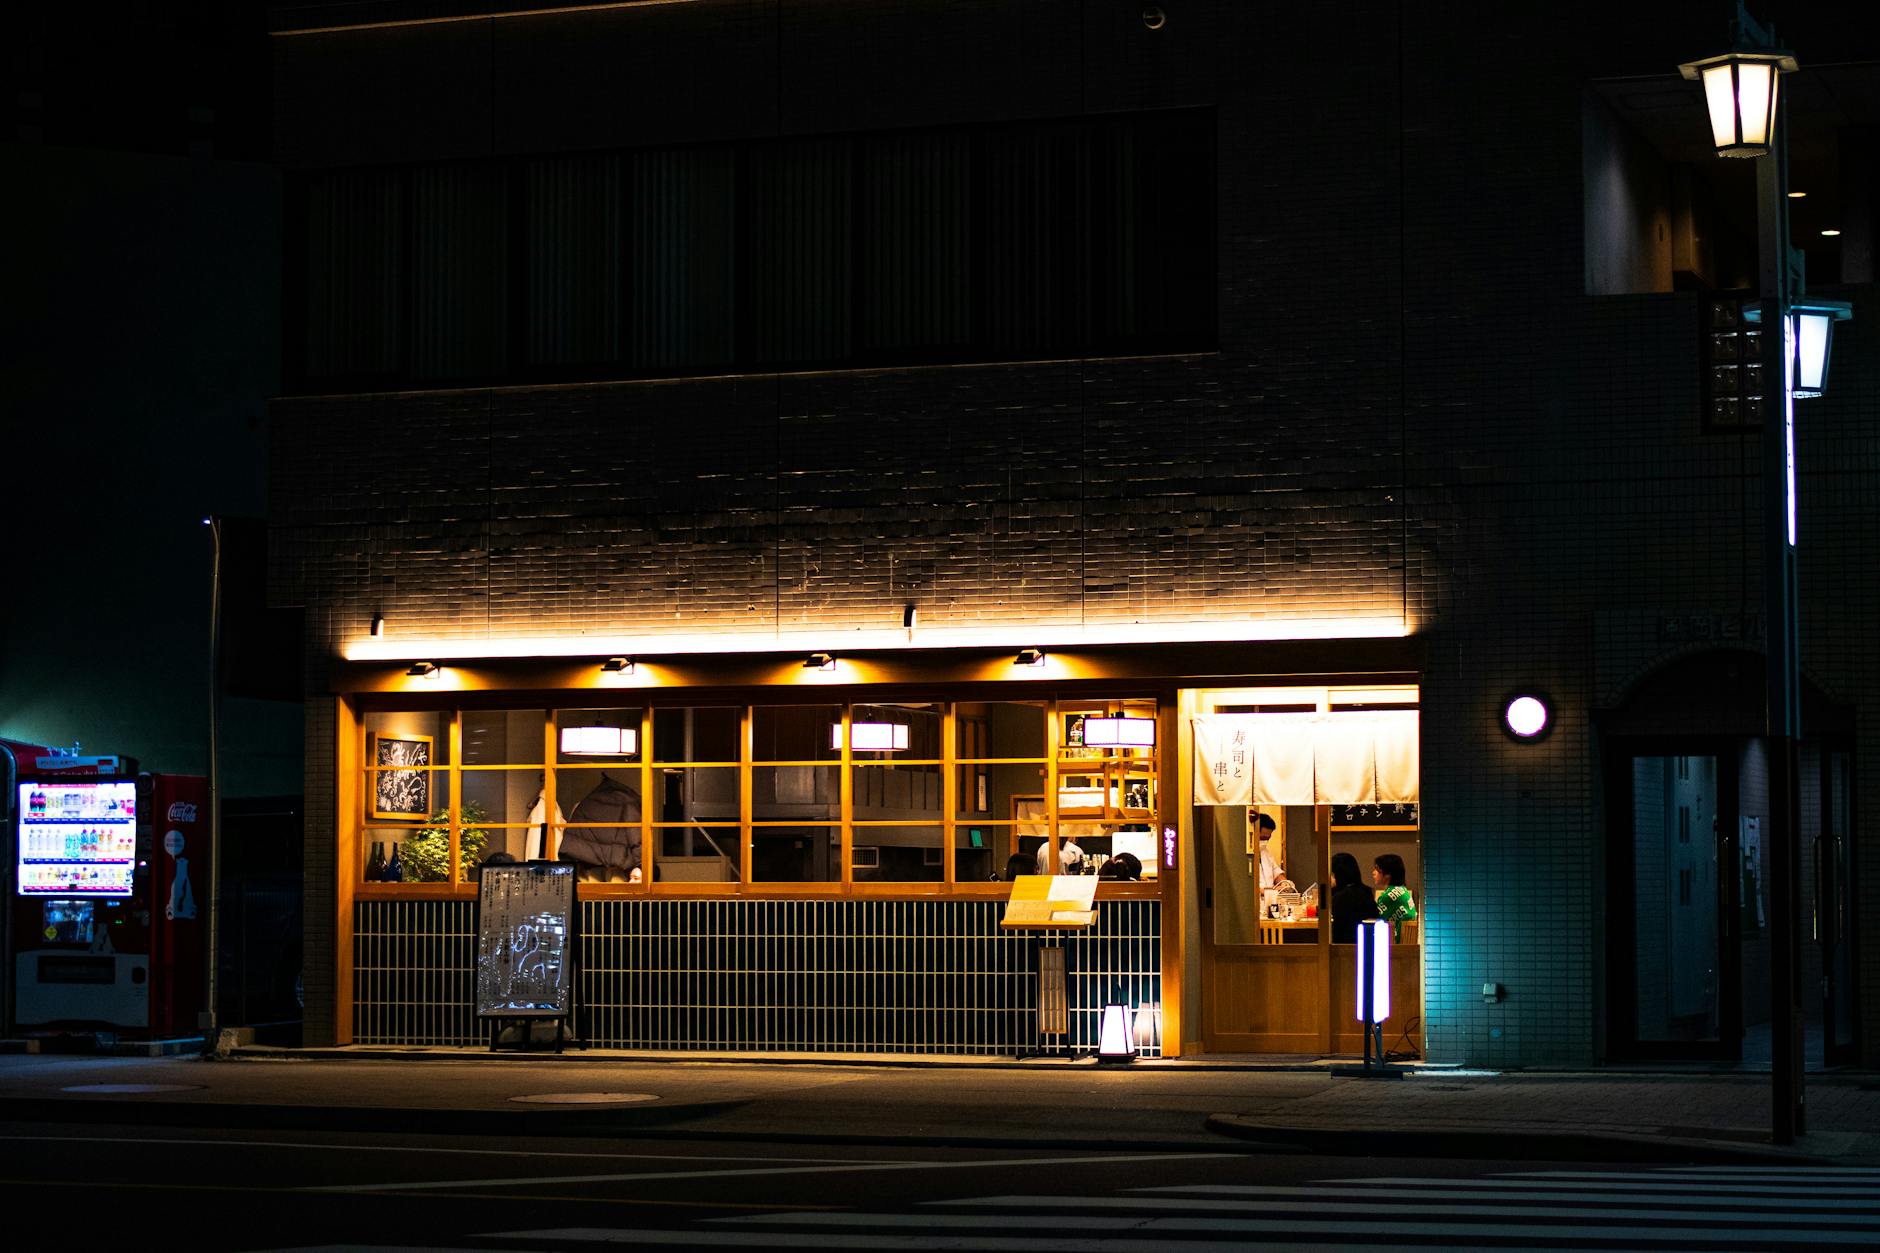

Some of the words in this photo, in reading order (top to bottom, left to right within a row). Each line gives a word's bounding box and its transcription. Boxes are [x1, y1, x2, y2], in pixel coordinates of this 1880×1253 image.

[1231, 729, 1246, 778] 寿司と
[1213, 761, 1228, 792] 串と
